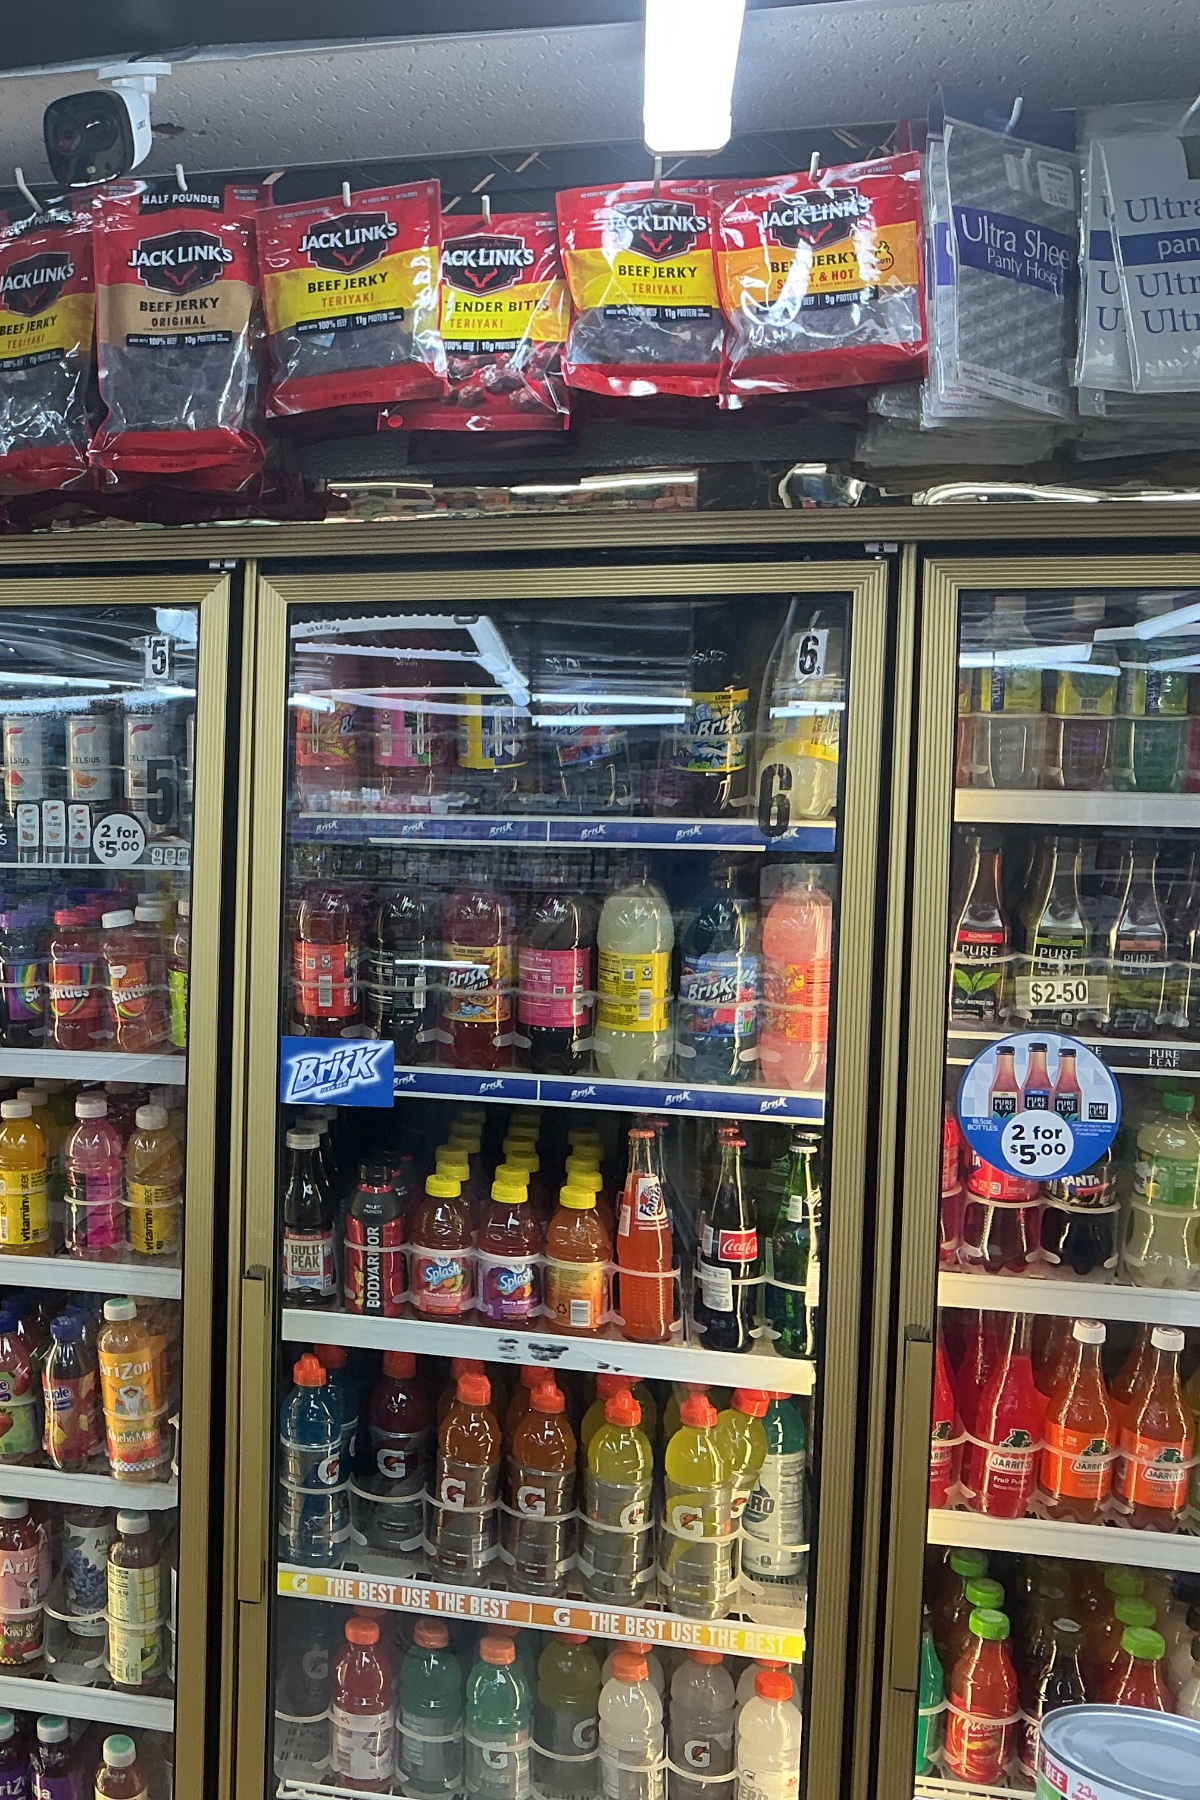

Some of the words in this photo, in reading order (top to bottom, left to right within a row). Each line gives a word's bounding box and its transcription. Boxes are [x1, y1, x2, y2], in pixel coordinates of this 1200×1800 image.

[143, 194, 168, 205] HALF
[172, 193, 220, 204] POUNDER
[653, 214, 707, 233] LINK'S
[761, 208, 810, 229] JACK
[298, 231, 343, 253] JACK
[345, 222, 398, 246] LINK'S
[960, 213, 1017, 254] Ultra
[127, 249, 176, 267] JACK
[177, 245, 234, 263] LINK'S
[1157, 237, 1200, 260] pan
[442, 249, 477, 267] ACK
[478, 247, 534, 267] LINK'S
[33, 262, 75, 285] LINK'S
[618, 264, 650, 277] BEEF
[652, 266, 698, 279] JERKY
[831, 269, 855, 281] HOT
[987, 248, 1023, 278] Panty
[1026, 261, 1058, 287] Hose
[308, 279, 341, 294] BEEF
[343, 271, 389, 291] JERKY
[631, 283, 683, 295] TERIYAKI
[1135, 272, 1200, 299] Ultr
[139, 300, 173, 313] BEEF
[174, 297, 220, 313] JERKY
[321, 292, 374, 308] TERIYAKI
[836, 292, 859, 303] PROTEIN
[0, 322, 25, 337] BEEF
[25, 315, 58, 332] JERKY
[151, 315, 206, 327] ORIGINAL
[318, 320, 336, 330] 100%
[336, 318, 347, 328] BEEF
[355, 315, 367, 327] 11g
[368, 313, 388, 324] PROTEIN
[450, 318, 504, 329] TERIYAKI
[7, 333, 45, 349] TERIYAKI
[149, 337, 166, 346] 100%
[444, 342, 461, 350] 100%
[150, 641, 168, 675] 5
[147, 758, 174, 825] 5
[758, 763, 793, 838] 6
[100, 824, 112, 838] 2
[116, 826, 139, 838] for
[99, 840, 140, 858] $5.00
[961, 944, 998, 957] PURE
[1039, 948, 1079, 960] PURE
[1123, 953, 1156, 965] PURE
[1149, 1048, 1181, 1060] PURE
[1149, 1058, 1180, 1068] LEAF
[967, 1124, 999, 1132] BOTTLES
[1011, 1124, 1026, 1140] 2
[1032, 1125, 1063, 1140] for
[1010, 1143, 1066, 1165] $5.00
[291, 1255, 321, 1269] PEAK
[425, 1261, 462, 1284] Splash
[500, 1268, 535, 1291] Splash
[991, 1456, 1033, 1471] JARRITOS
[325, 1576, 354, 1598] THE
[358, 1581, 398, 1604] BEST
[401, 1586, 431, 1609] USE
[435, 1590, 465, 1614] THE
[470, 1595, 510, 1619] BEST
[553, 1608, 571, 1627] G
[589, 1611, 620, 1634] THE
[624, 1615, 666, 1640] BEST
[670, 1621, 702, 1645] USE
[708, 1625, 739, 1650] THE
[744, 1630, 788, 1656] BEST
